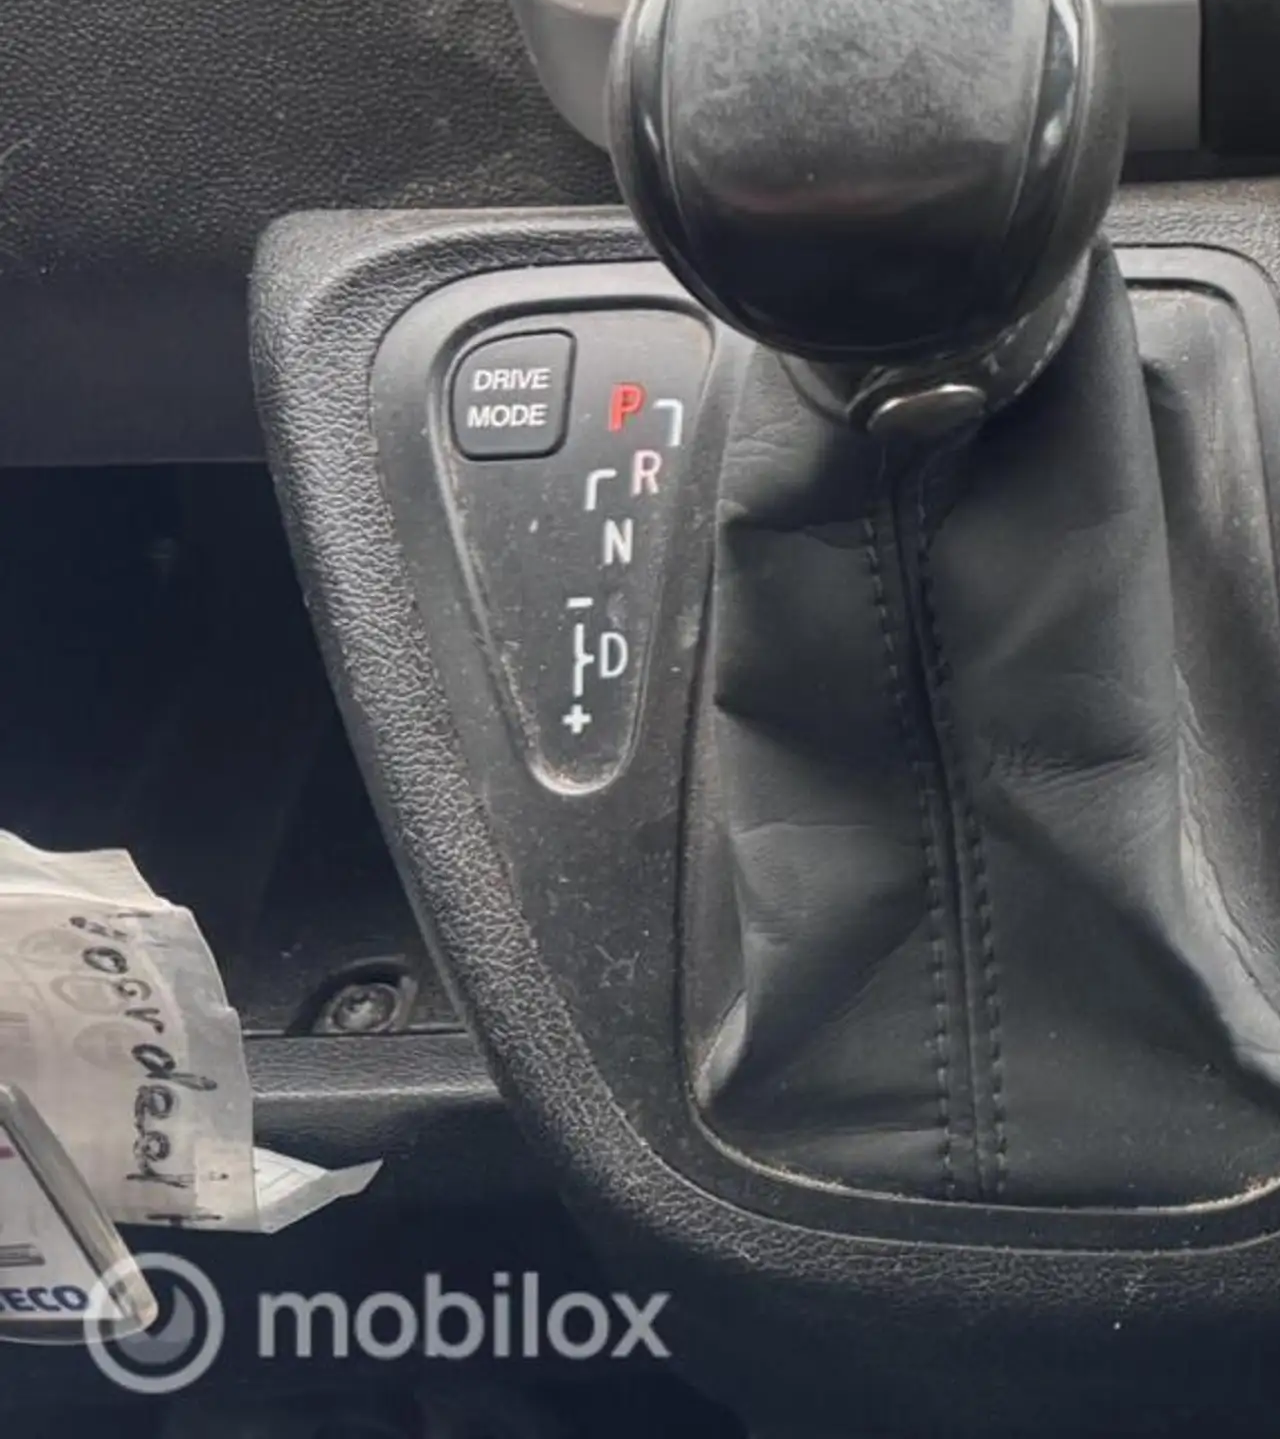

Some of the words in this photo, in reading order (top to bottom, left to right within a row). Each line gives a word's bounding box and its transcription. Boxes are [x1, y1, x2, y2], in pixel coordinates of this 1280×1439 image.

[473, 367, 552, 393] DRIVE
[466, 404, 548, 429] MODE
[610, 384, 645, 432] P
[631, 450, 662, 496] R
[604, 517, 633, 565] N
[599, 631, 629, 679] D
